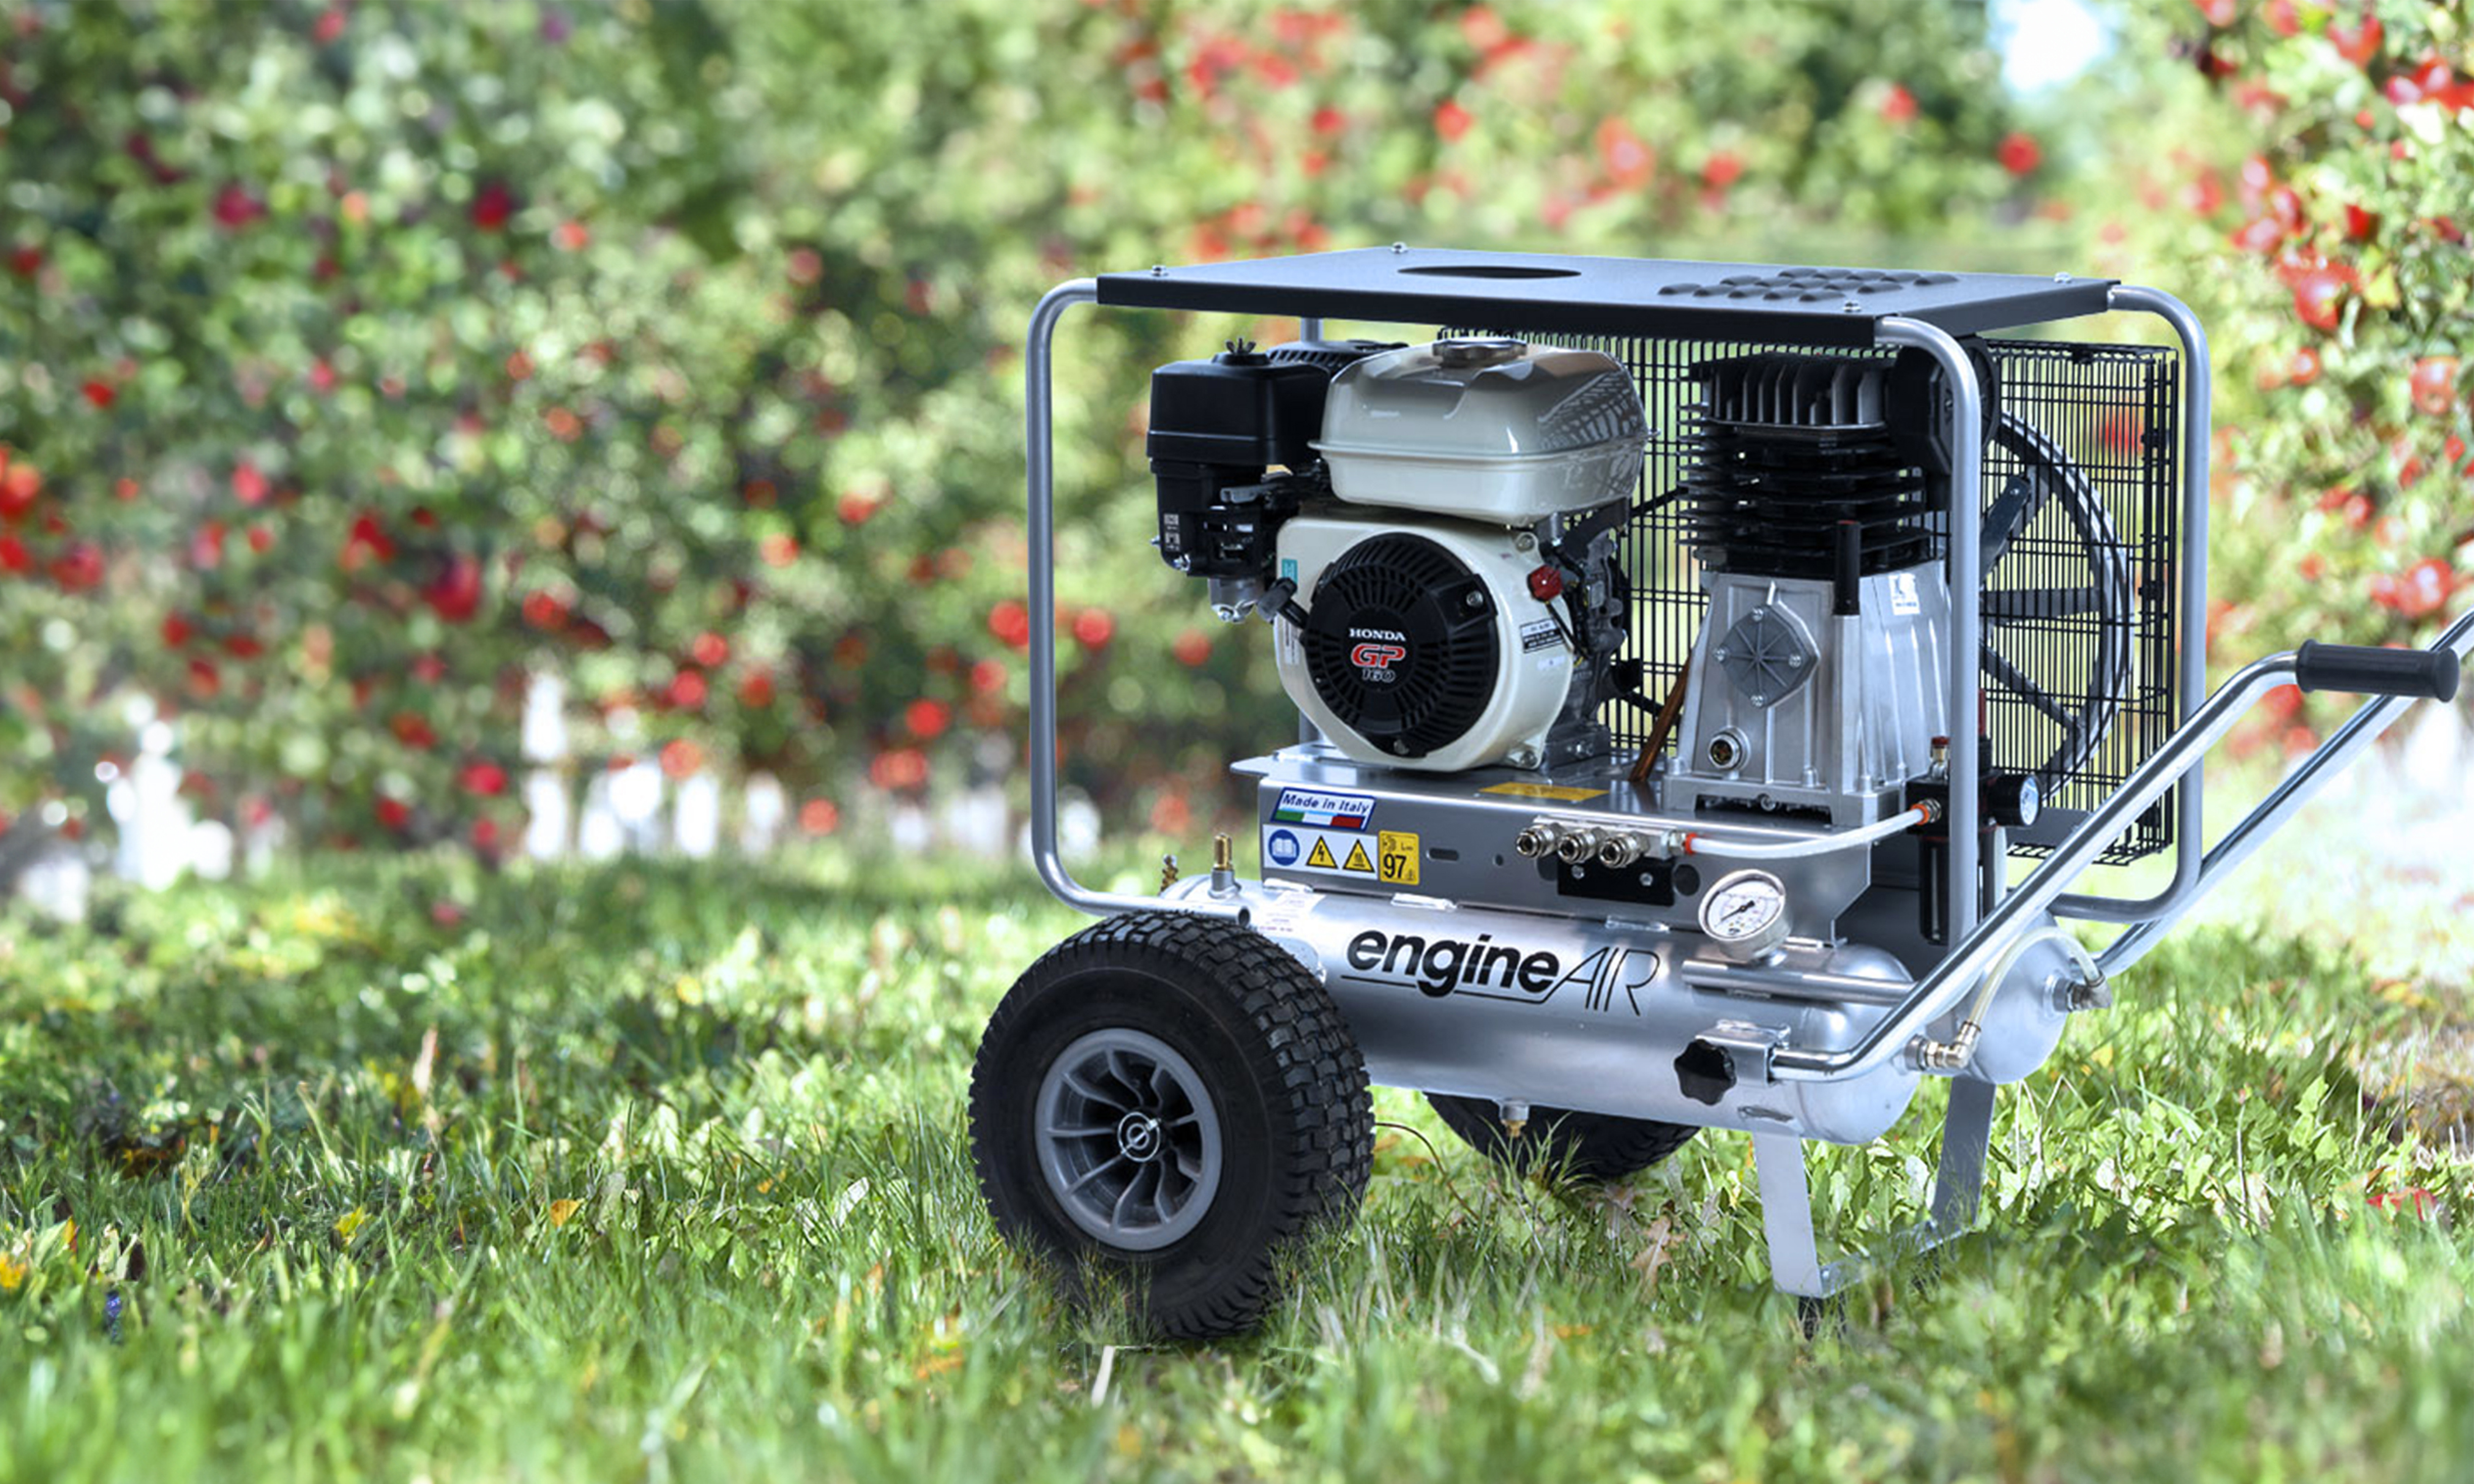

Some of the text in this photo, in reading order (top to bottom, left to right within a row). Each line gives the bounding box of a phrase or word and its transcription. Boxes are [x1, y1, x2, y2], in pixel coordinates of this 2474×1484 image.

[1349, 628, 1406, 642] HONDA
[1350, 643, 1406, 668] GP
[1362, 668, 1396, 683] 160
[1283, 793, 1370, 814] Made in Italy
[1383, 853, 1406, 879] 97
